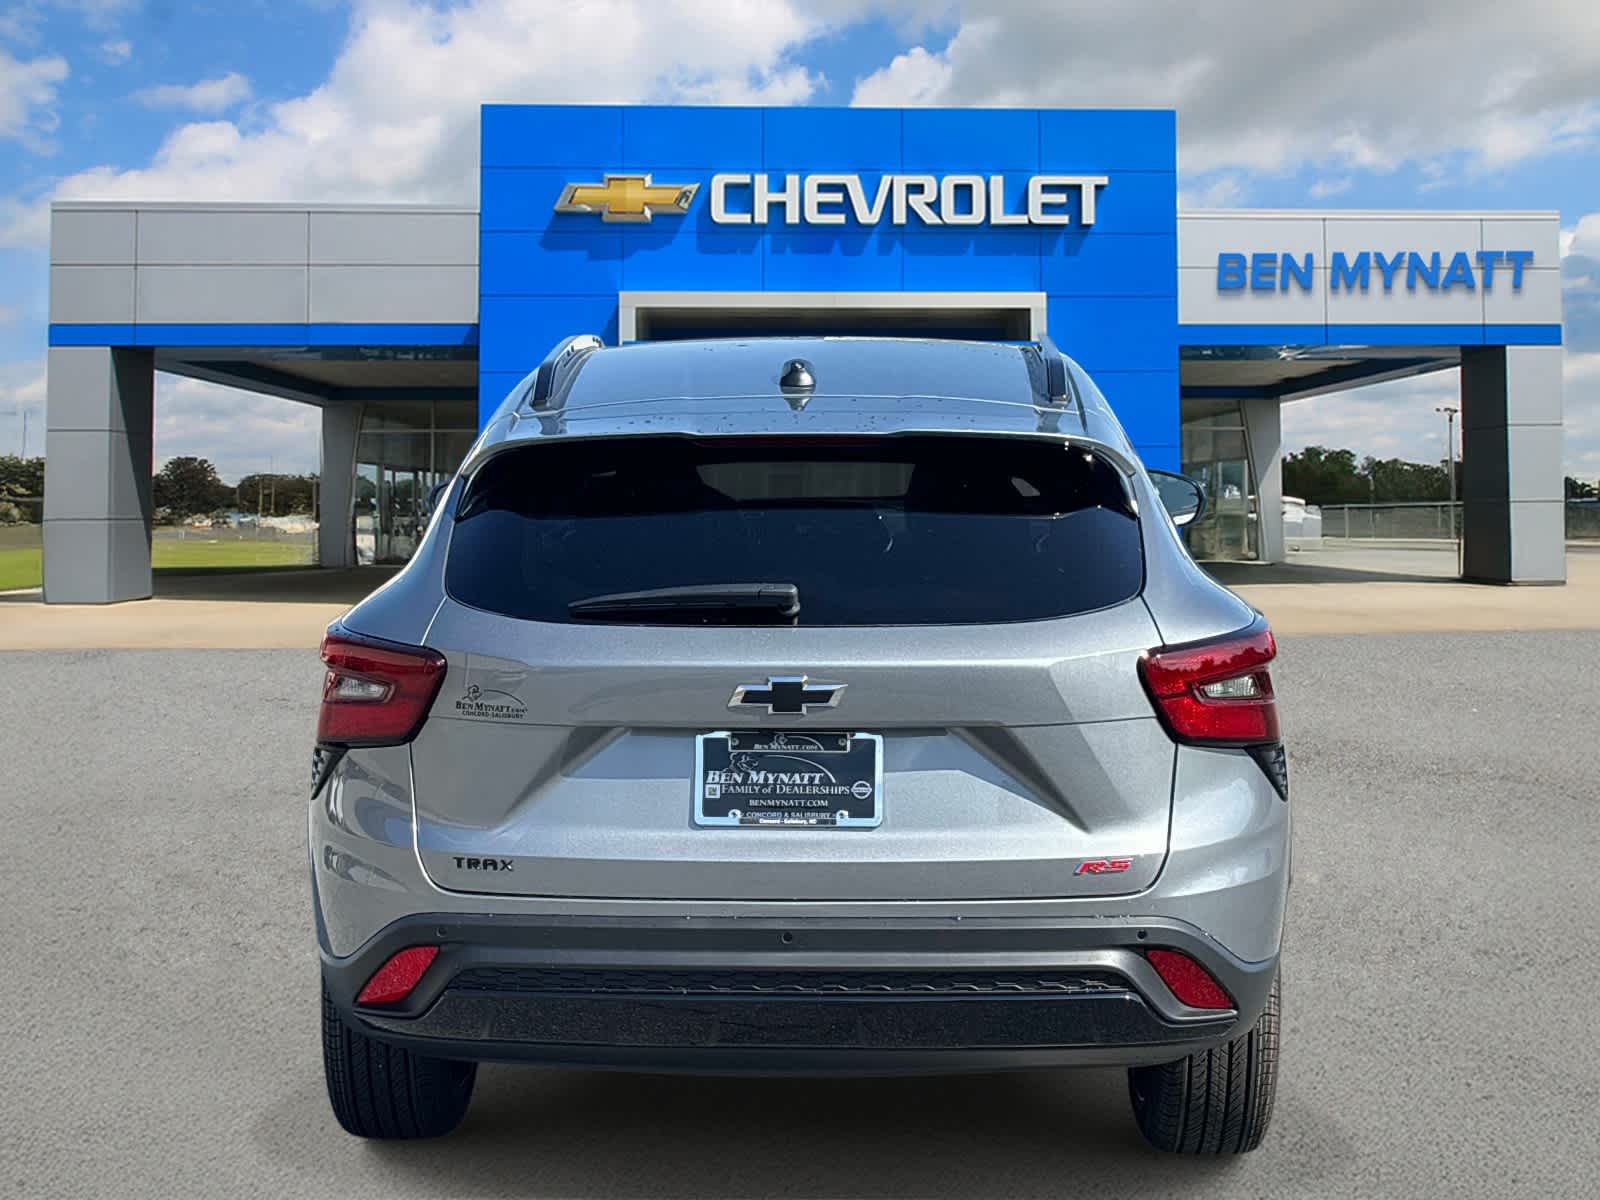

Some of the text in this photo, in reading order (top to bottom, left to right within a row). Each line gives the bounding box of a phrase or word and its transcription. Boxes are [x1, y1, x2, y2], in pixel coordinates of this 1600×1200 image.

[710, 174, 1109, 226] CHEVROLET
[1217, 250, 1534, 290] BEN MYNATT
[455, 700, 473, 710] BEN
[706, 770, 825, 785] BEN MYNATT
[721, 784, 761, 794] FAMILY
[761, 785, 775, 794] of
[776, 784, 850, 795] DEALERSHIPS
[748, 799, 829, 807] BENMYNATT.COM
[453, 857, 514, 871] TRAX
[1073, 858, 1134, 875] RS
